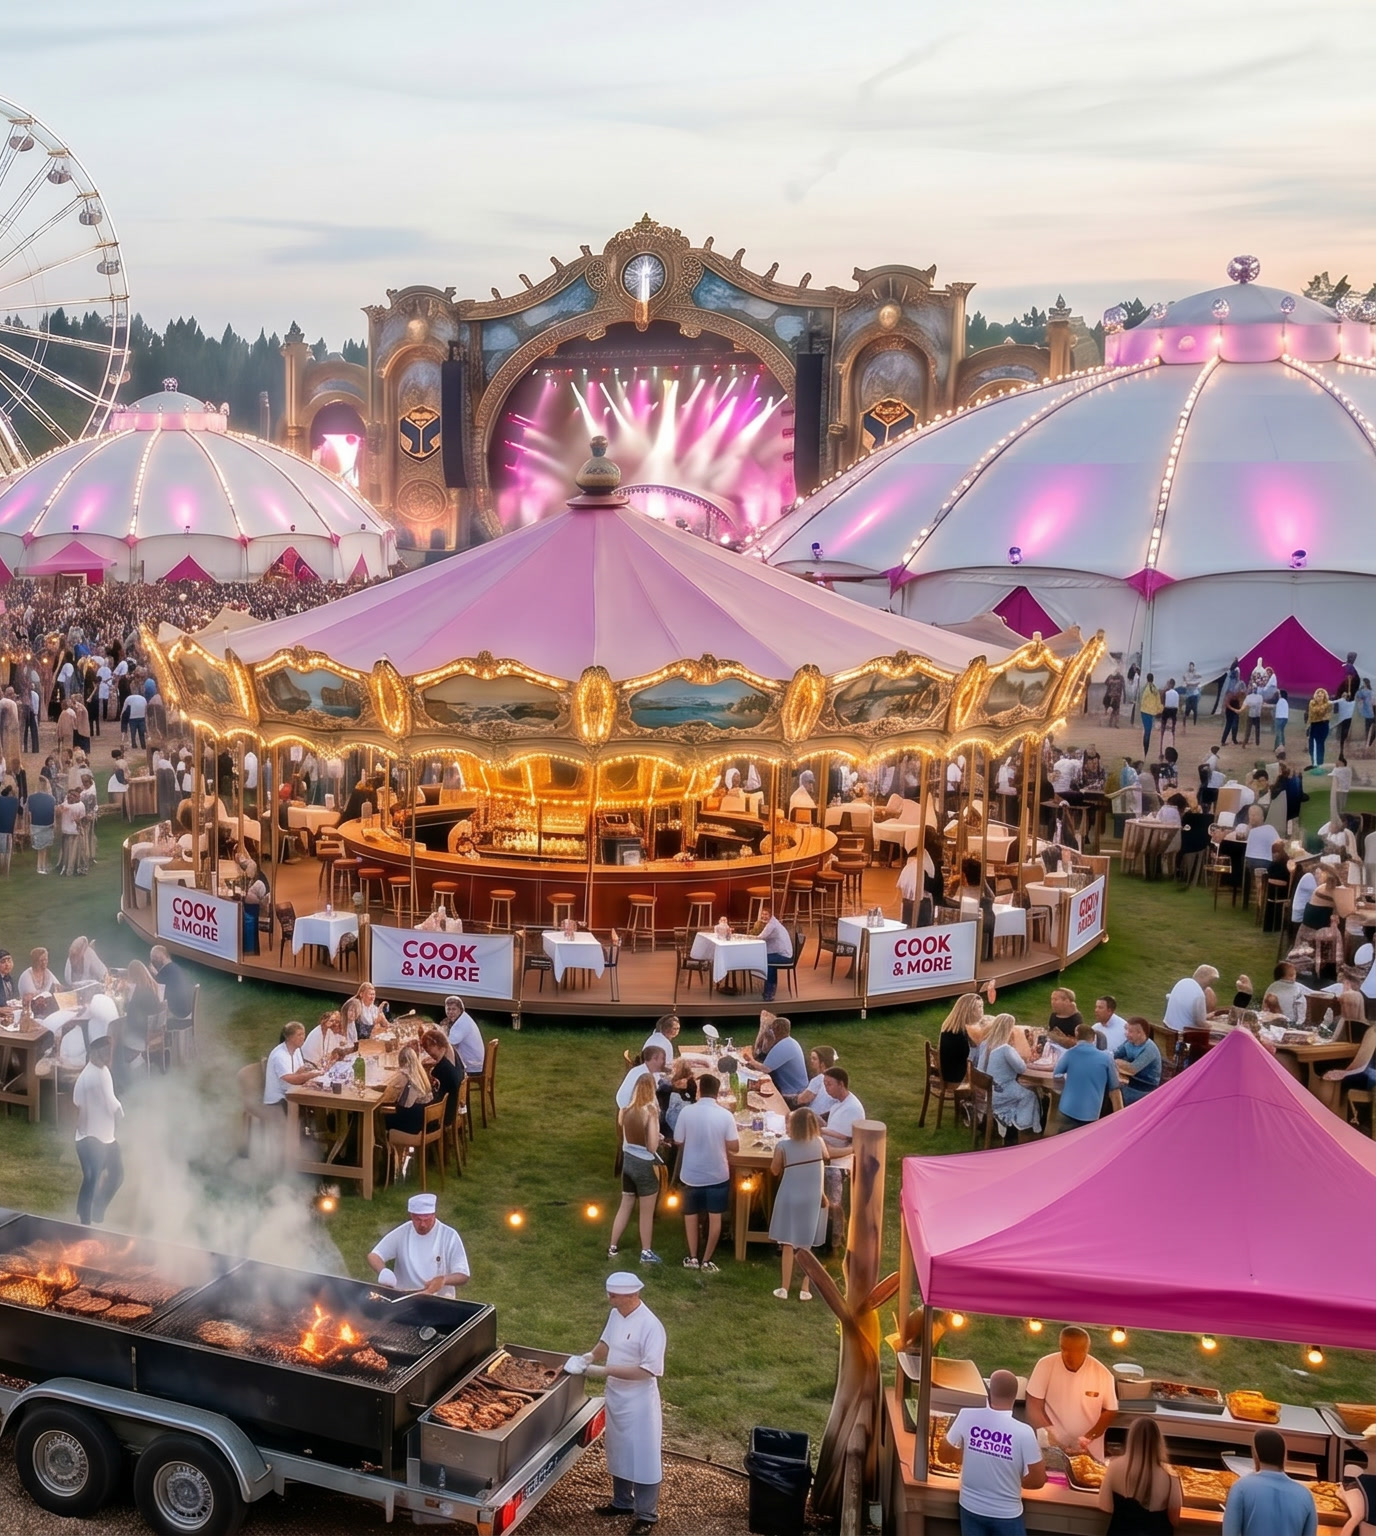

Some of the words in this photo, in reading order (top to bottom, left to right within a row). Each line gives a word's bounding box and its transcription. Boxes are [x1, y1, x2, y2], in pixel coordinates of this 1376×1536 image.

[173, 897, 218, 926] COOK
[182, 919, 219, 942] MORE
[403, 940, 478, 964] COOK
[894, 933, 951, 958] COOK
[401, 960, 415, 976] &
[418, 962, 480, 983] MORE
[892, 962, 904, 976] &
[907, 955, 952, 975] MORE
[970, 1426, 1013, 1446] COOK
